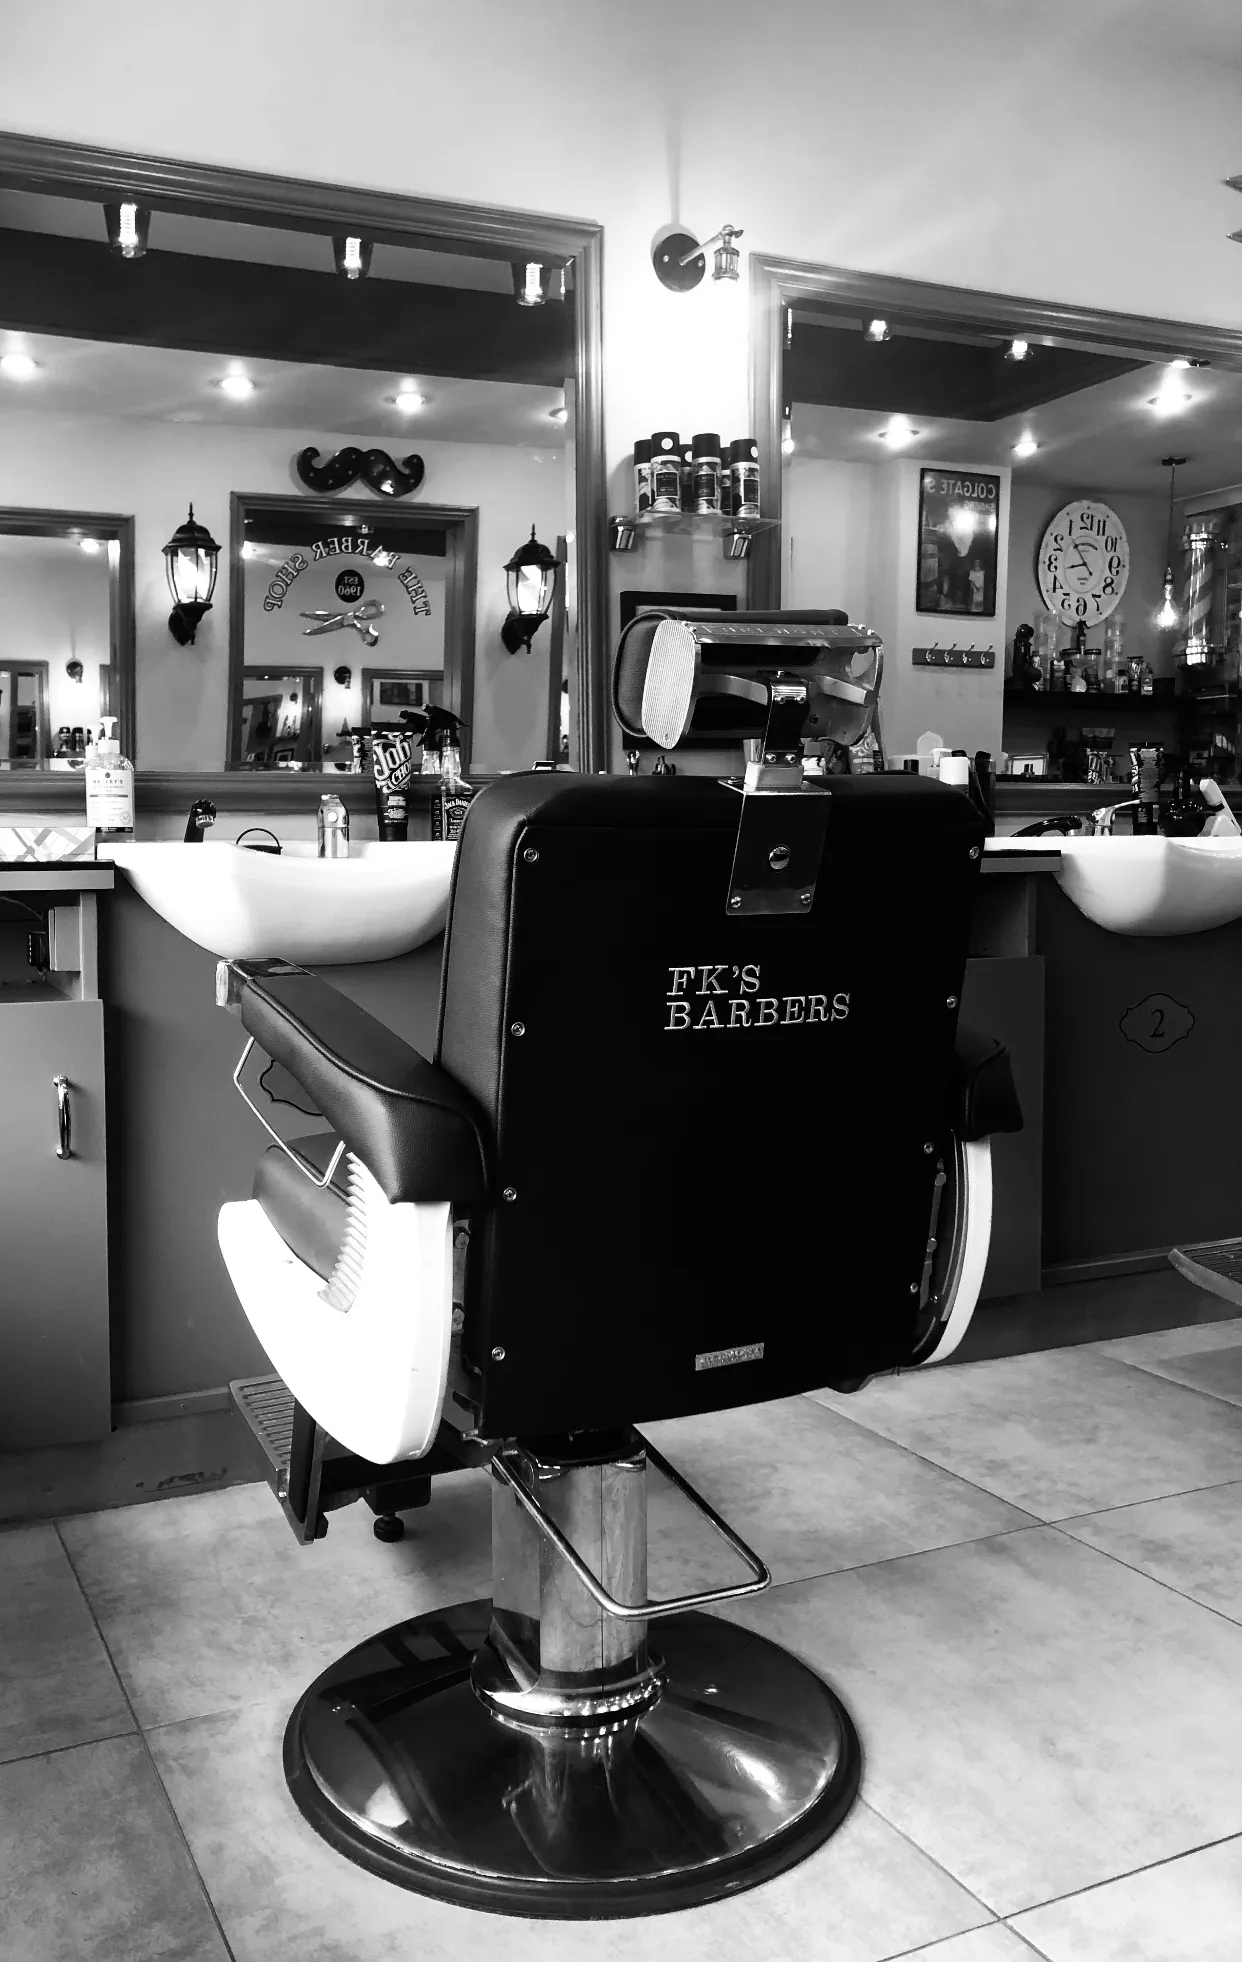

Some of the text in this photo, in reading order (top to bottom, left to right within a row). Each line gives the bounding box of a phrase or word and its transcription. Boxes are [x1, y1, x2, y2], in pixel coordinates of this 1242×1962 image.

[666, 964, 761, 996] FK'S
[664, 992, 851, 1031] BARBERS
[1150, 1008, 1166, 1038] 2
